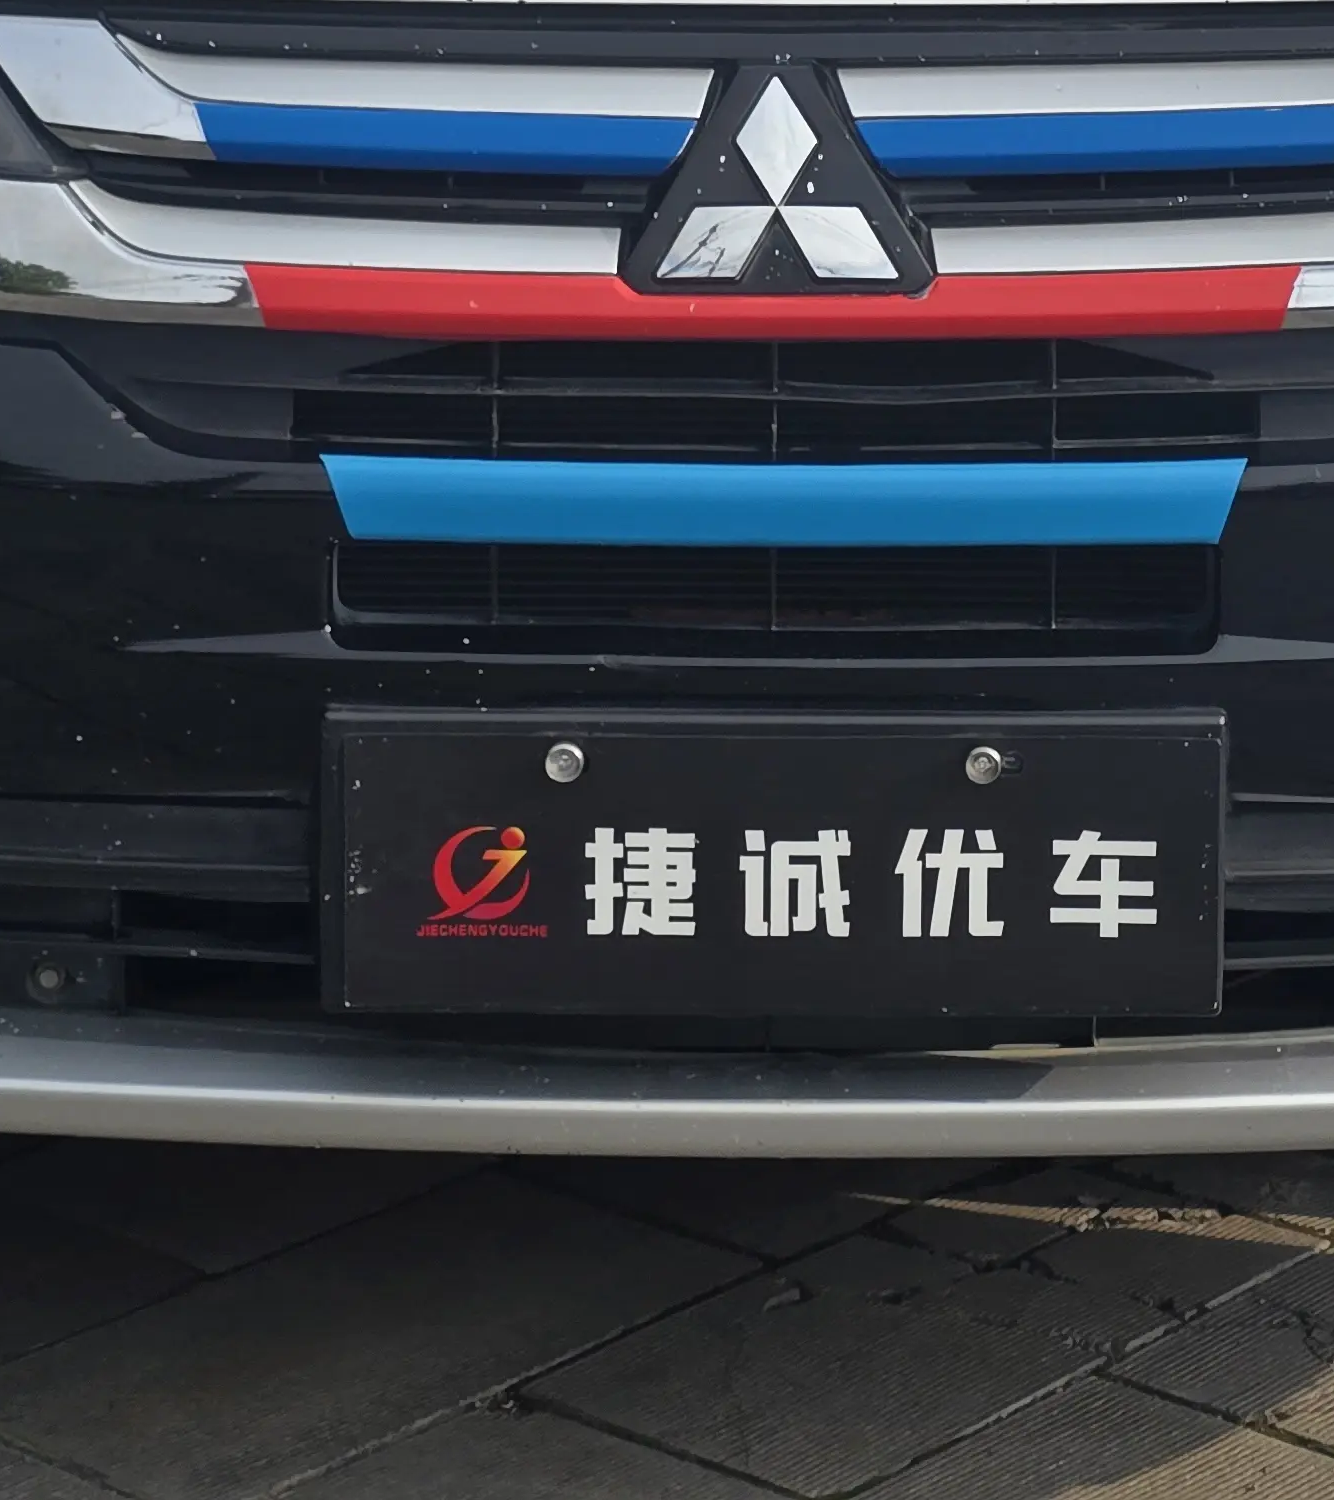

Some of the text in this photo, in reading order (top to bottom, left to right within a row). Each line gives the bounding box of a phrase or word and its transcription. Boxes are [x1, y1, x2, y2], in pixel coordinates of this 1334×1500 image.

[584, 827, 1159, 938] 捷诚优车
[416, 924, 548, 938] JIECHENGYOUCHE
